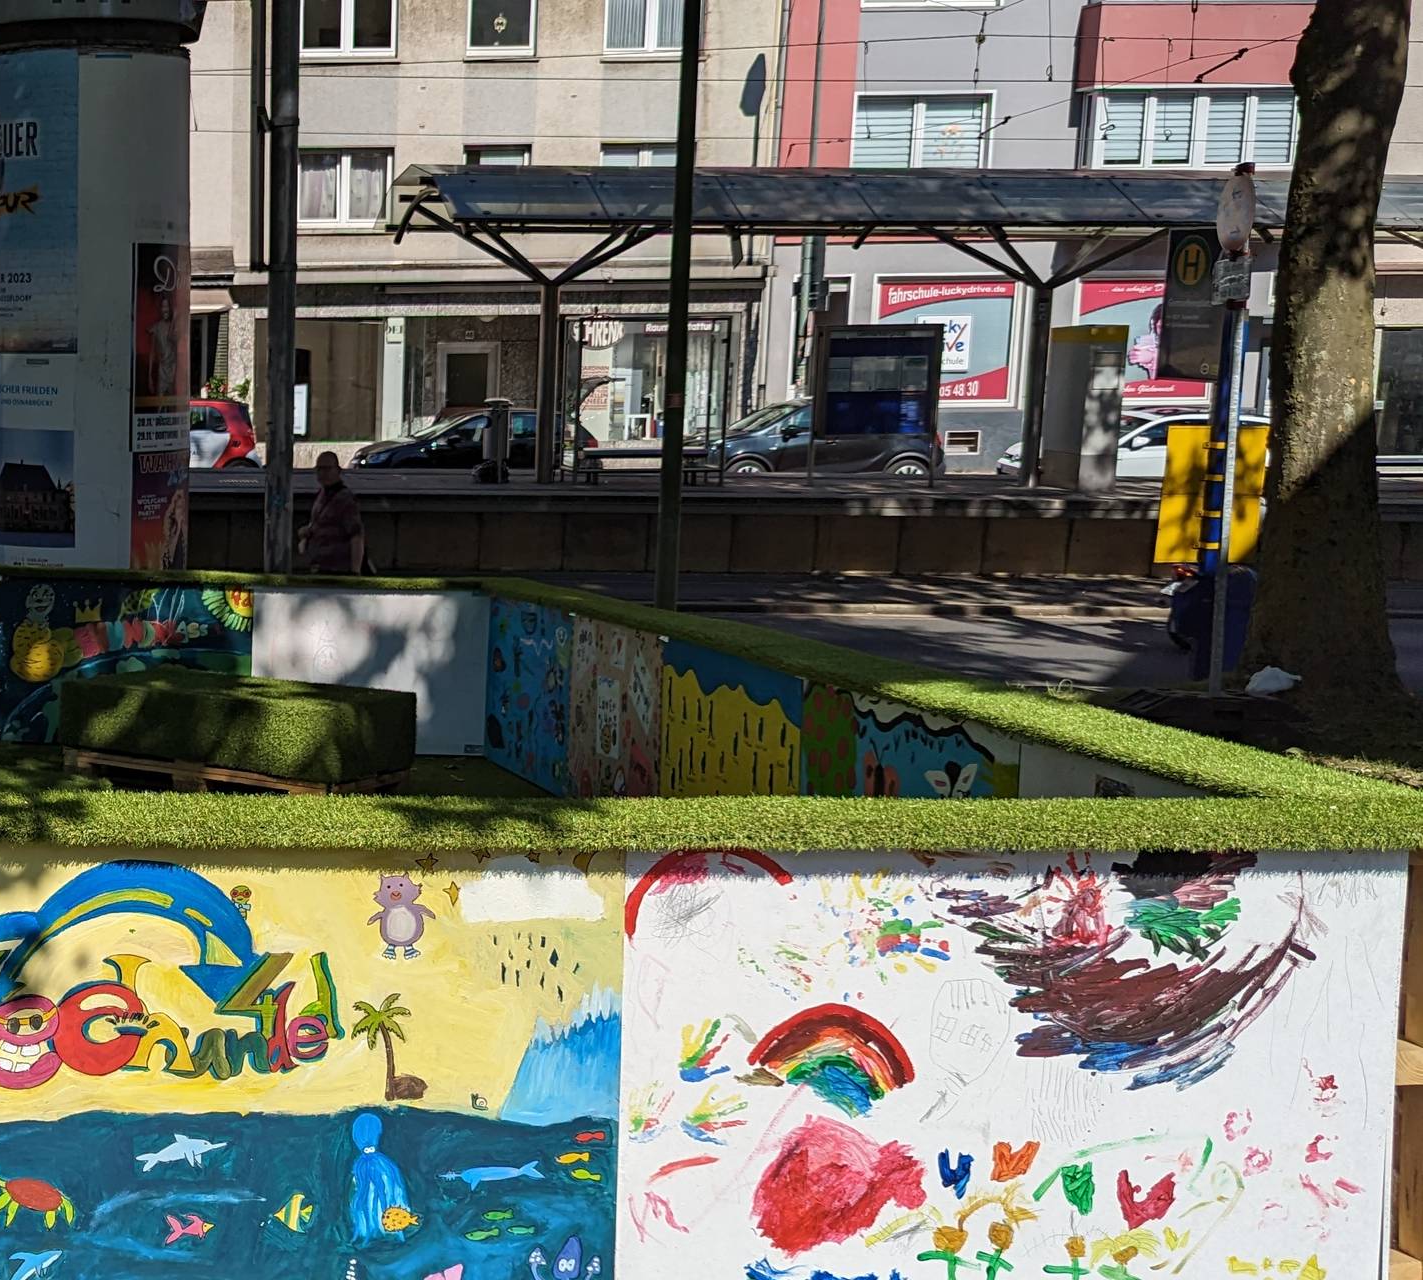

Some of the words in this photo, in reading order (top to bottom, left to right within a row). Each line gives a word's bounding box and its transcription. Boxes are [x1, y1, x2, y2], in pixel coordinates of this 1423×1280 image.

[1183, 250, 1201, 280] H
[8, 272, 32, 284] 2023
[888, 285, 1007, 305] fahrschule-luckydrive.de
[21, 385, 58, 395] FRIEDEN
[952, 383, 965, 397] 48
[966, 380, 979, 397] 30
